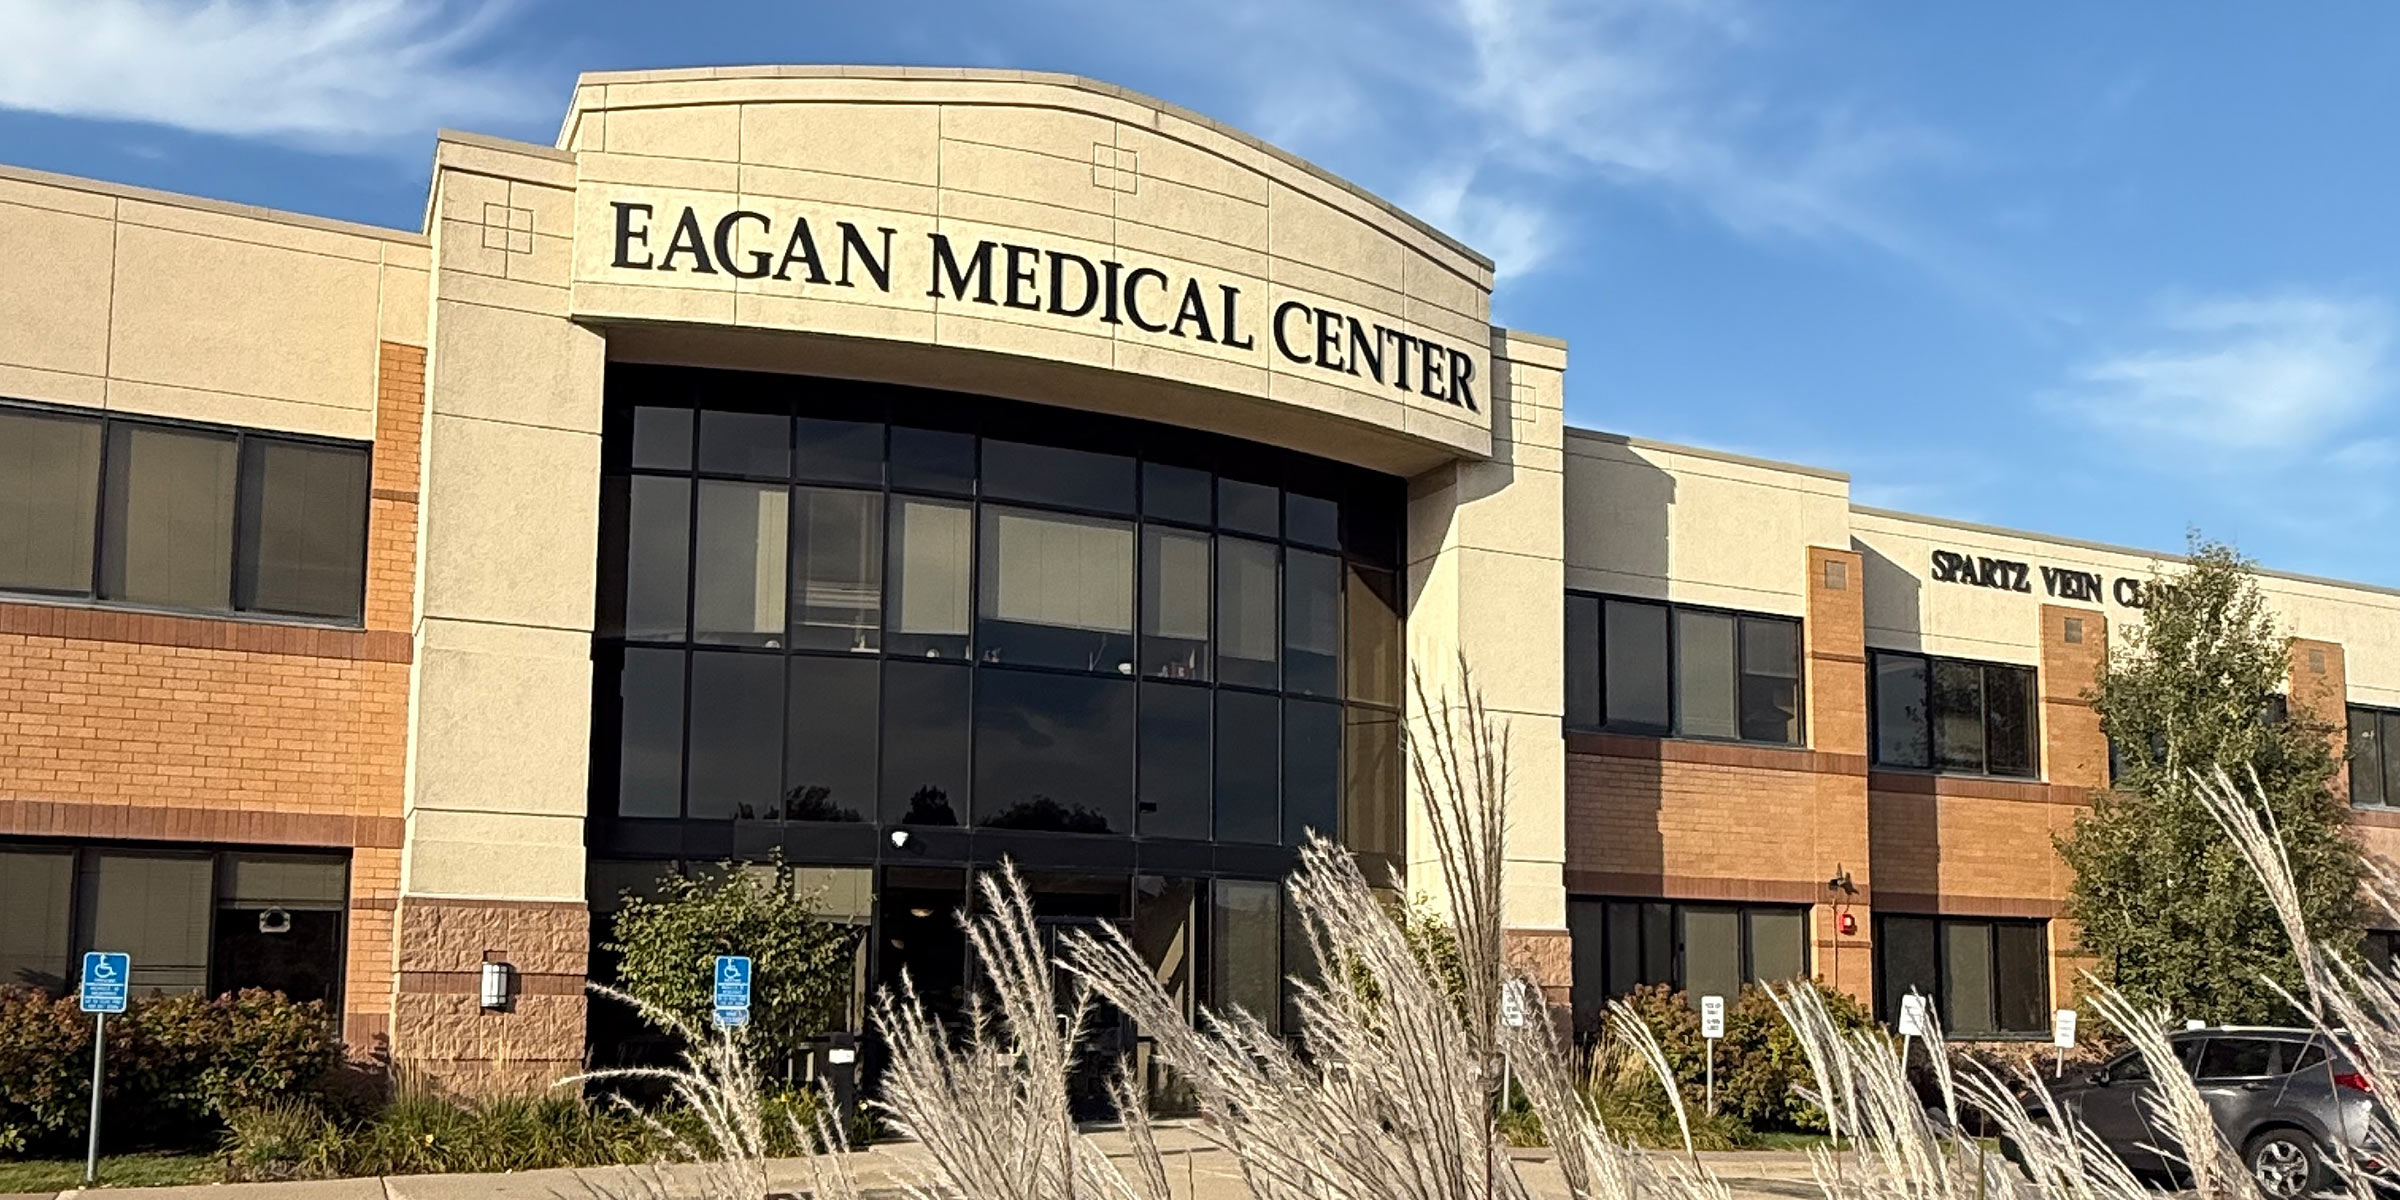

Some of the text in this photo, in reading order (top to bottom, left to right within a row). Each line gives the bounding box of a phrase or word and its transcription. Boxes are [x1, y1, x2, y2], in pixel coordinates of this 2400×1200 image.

[610, 201, 1478, 412] EAGAN MEDICAL CENTER
[1932, 549, 2031, 594] SPARTZ
[2039, 566, 2103, 603] VEIN
